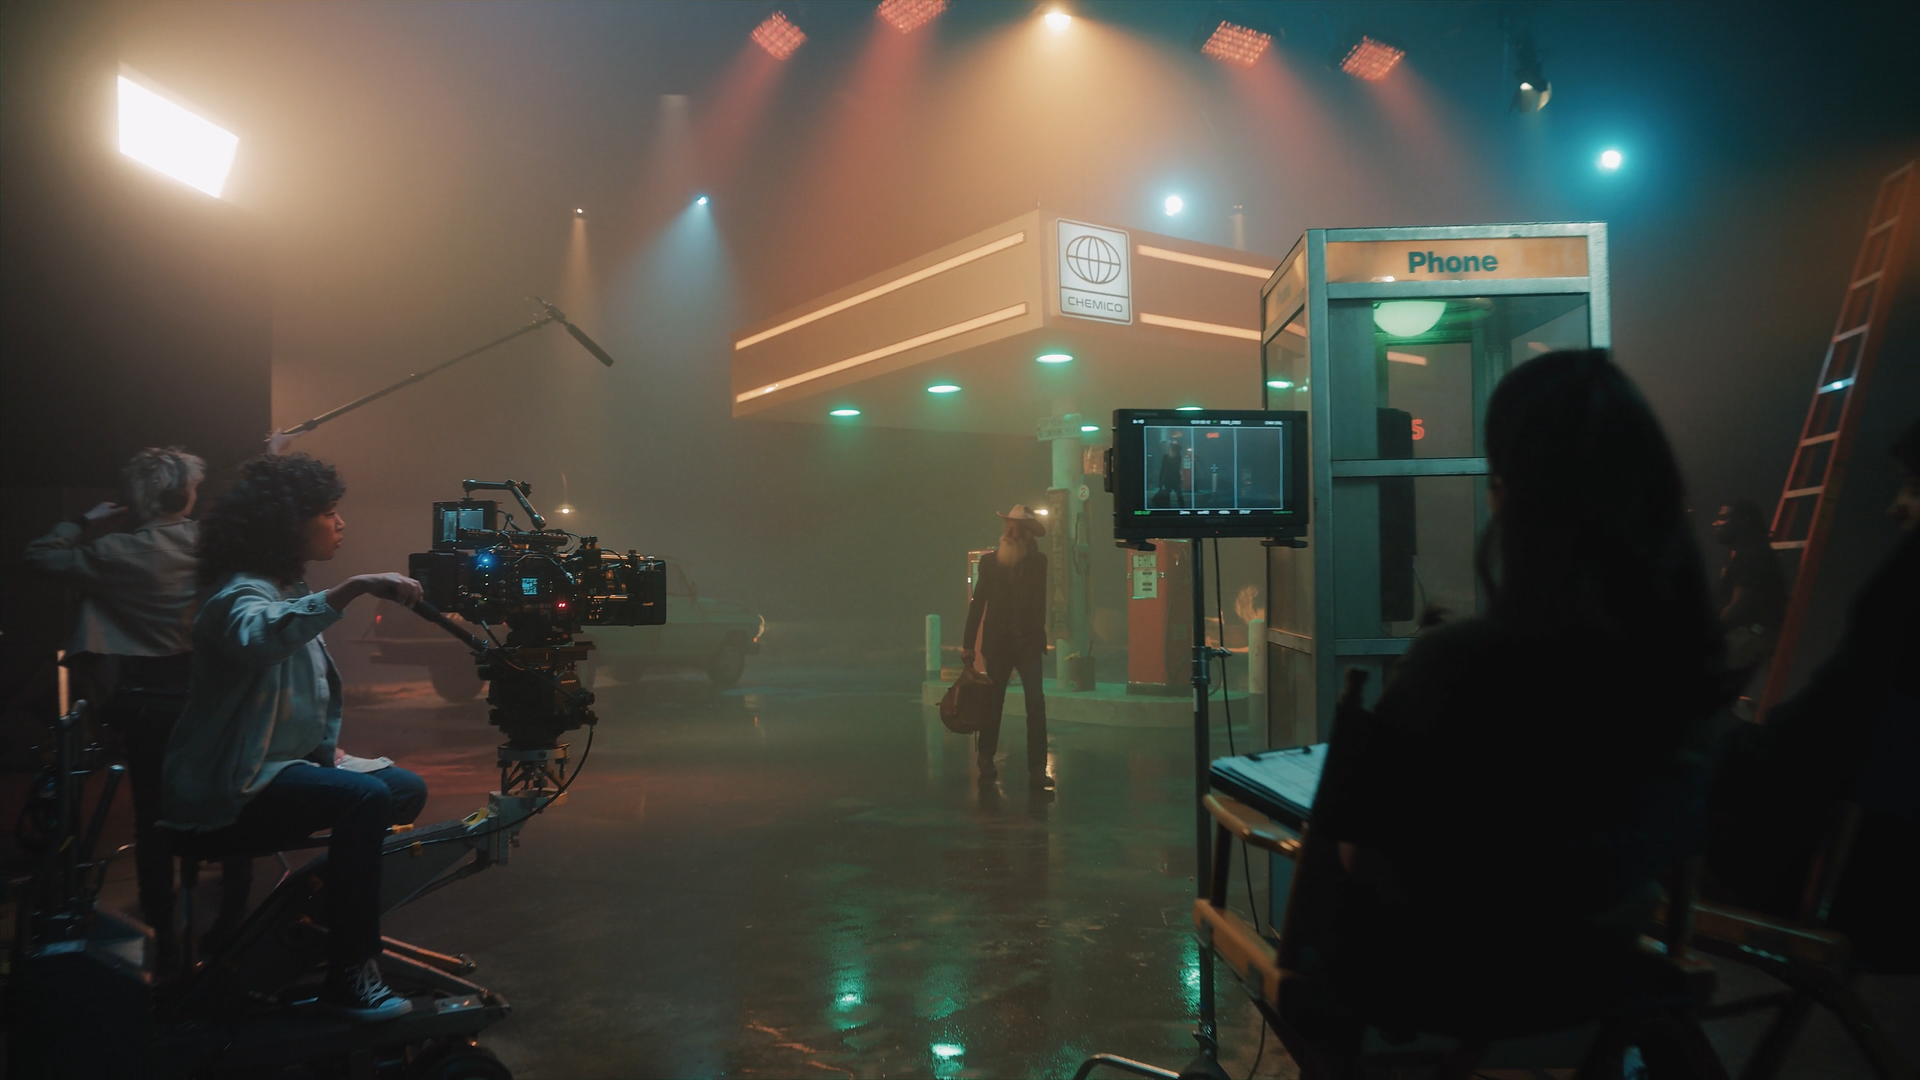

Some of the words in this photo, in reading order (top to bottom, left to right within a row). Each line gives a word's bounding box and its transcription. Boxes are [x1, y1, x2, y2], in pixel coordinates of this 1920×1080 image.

[1408, 251, 1498, 274] Phone
[1067, 296, 1123, 313] CHEMICO
[1080, 487, 1087, 498] 2
